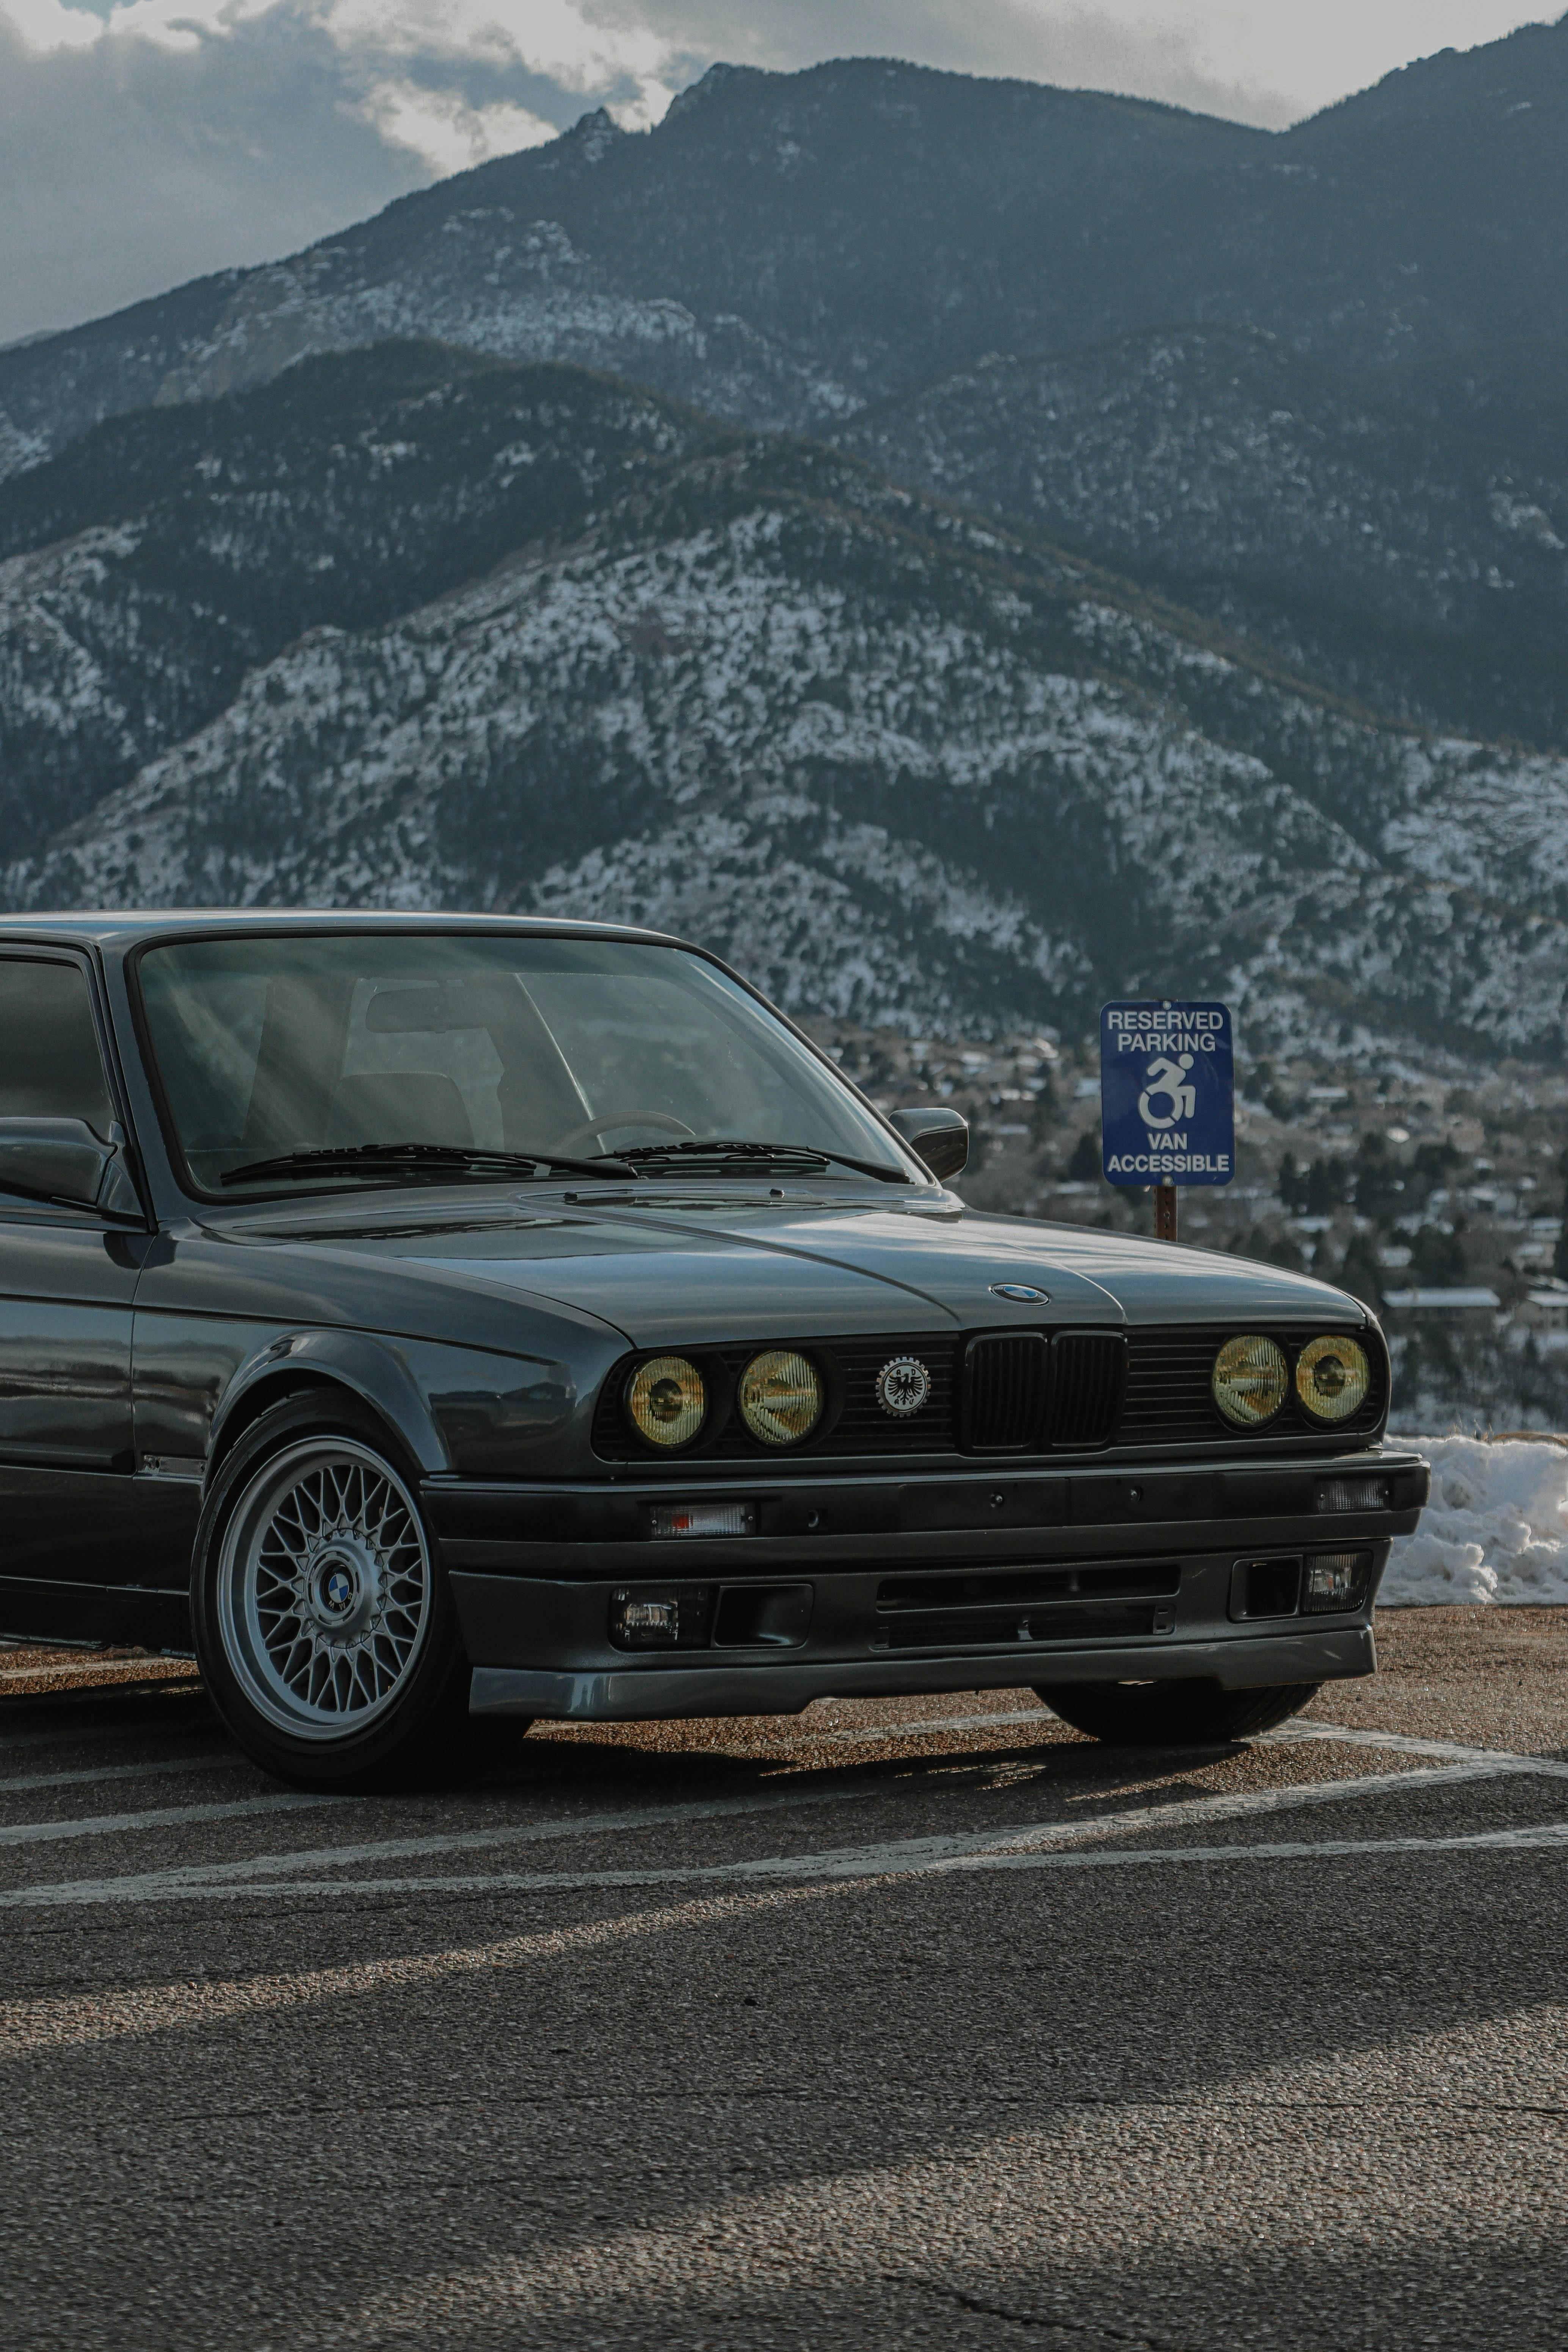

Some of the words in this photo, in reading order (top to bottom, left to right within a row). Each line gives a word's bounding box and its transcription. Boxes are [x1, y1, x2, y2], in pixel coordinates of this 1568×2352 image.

[1108, 1011, 1223, 1030] RESERVED
[1118, 1033, 1216, 1052] PARKING
[1148, 1134, 1187, 1150] VAN
[1108, 1155, 1229, 1172] ACCESSIBLE
[329, 1592, 353, 1610] BMW
